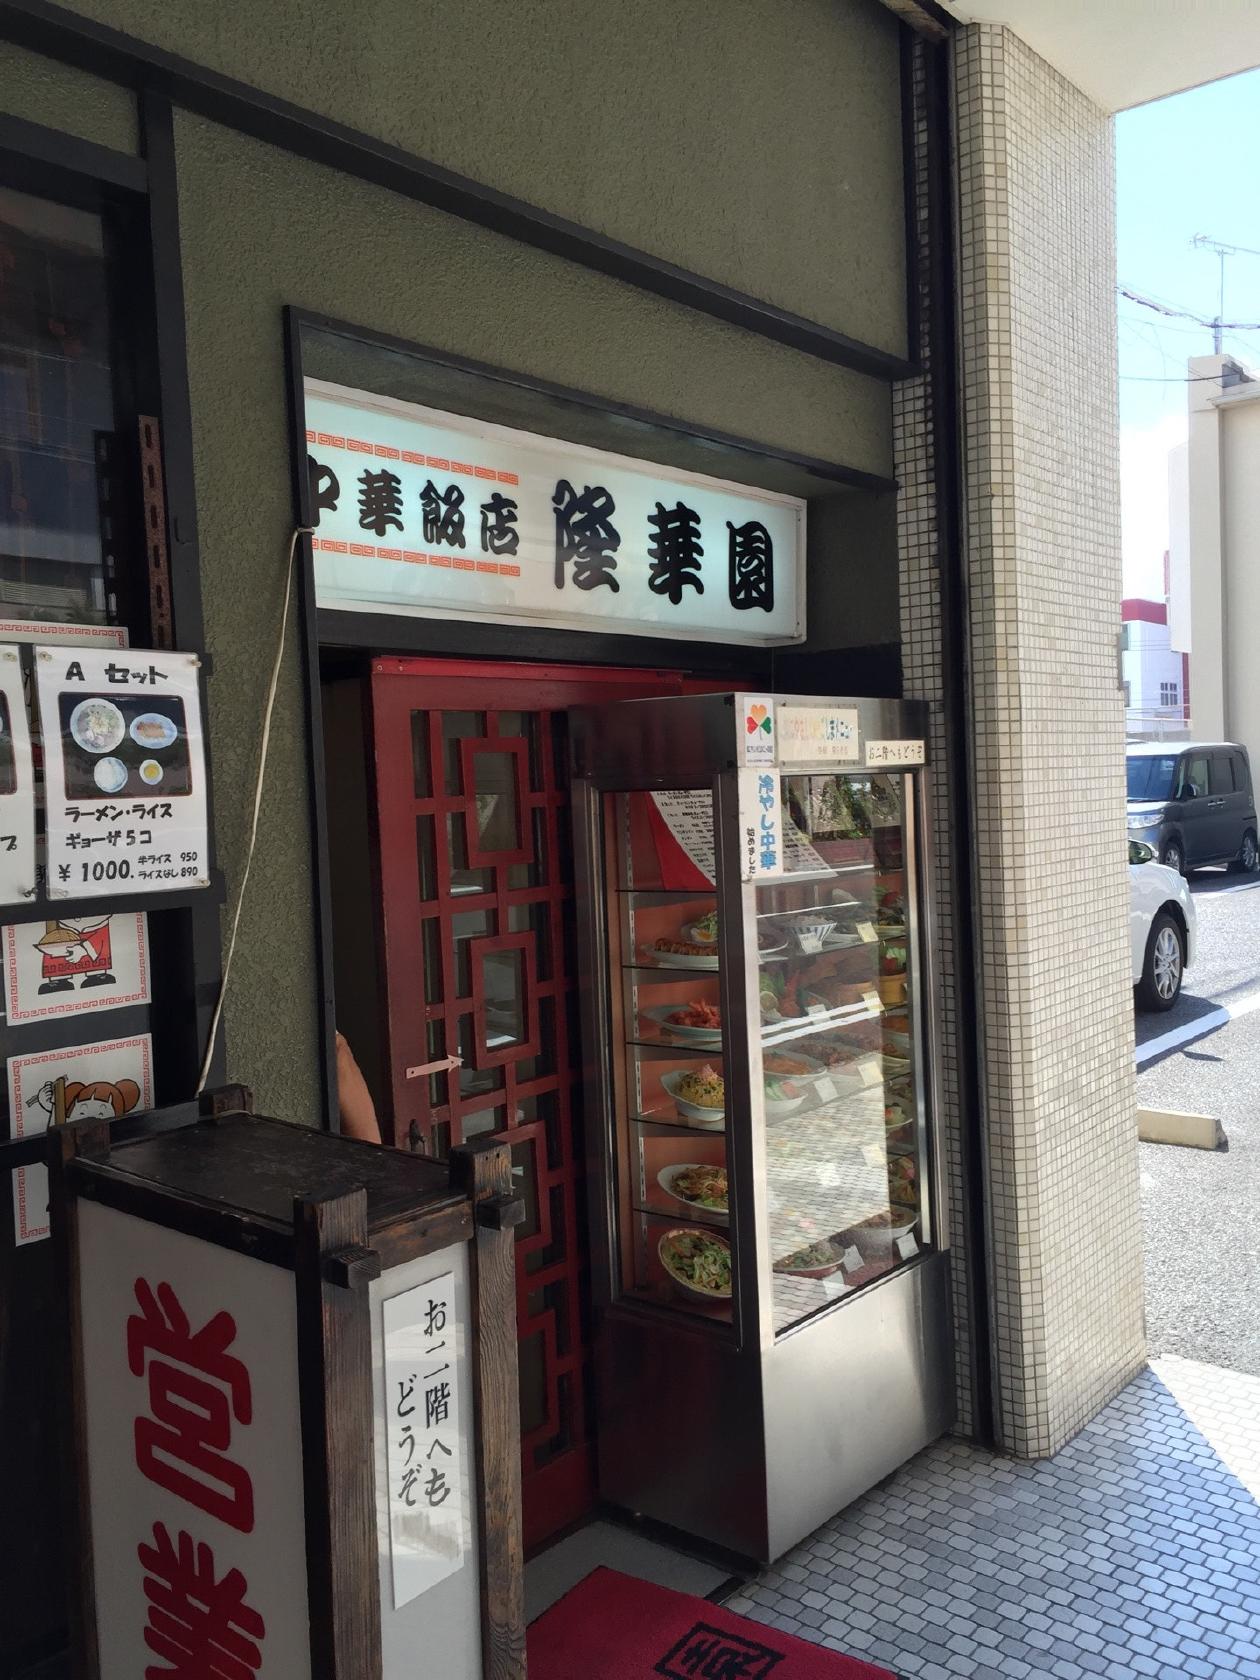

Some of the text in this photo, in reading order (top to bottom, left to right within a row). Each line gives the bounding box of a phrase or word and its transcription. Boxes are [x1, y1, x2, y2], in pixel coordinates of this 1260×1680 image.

[65, 661, 168, 685] A セット
[64, 802, 173, 823] ラーメン・ライス
[758, 774, 777, 871] 冷やし中華
[179, 851, 198, 863] 950
[137, 866, 198, 880] ライスなし 890
[423, 1299, 453, 1508] お二階へも
[397, 1374, 423, 1507] どうぞ
